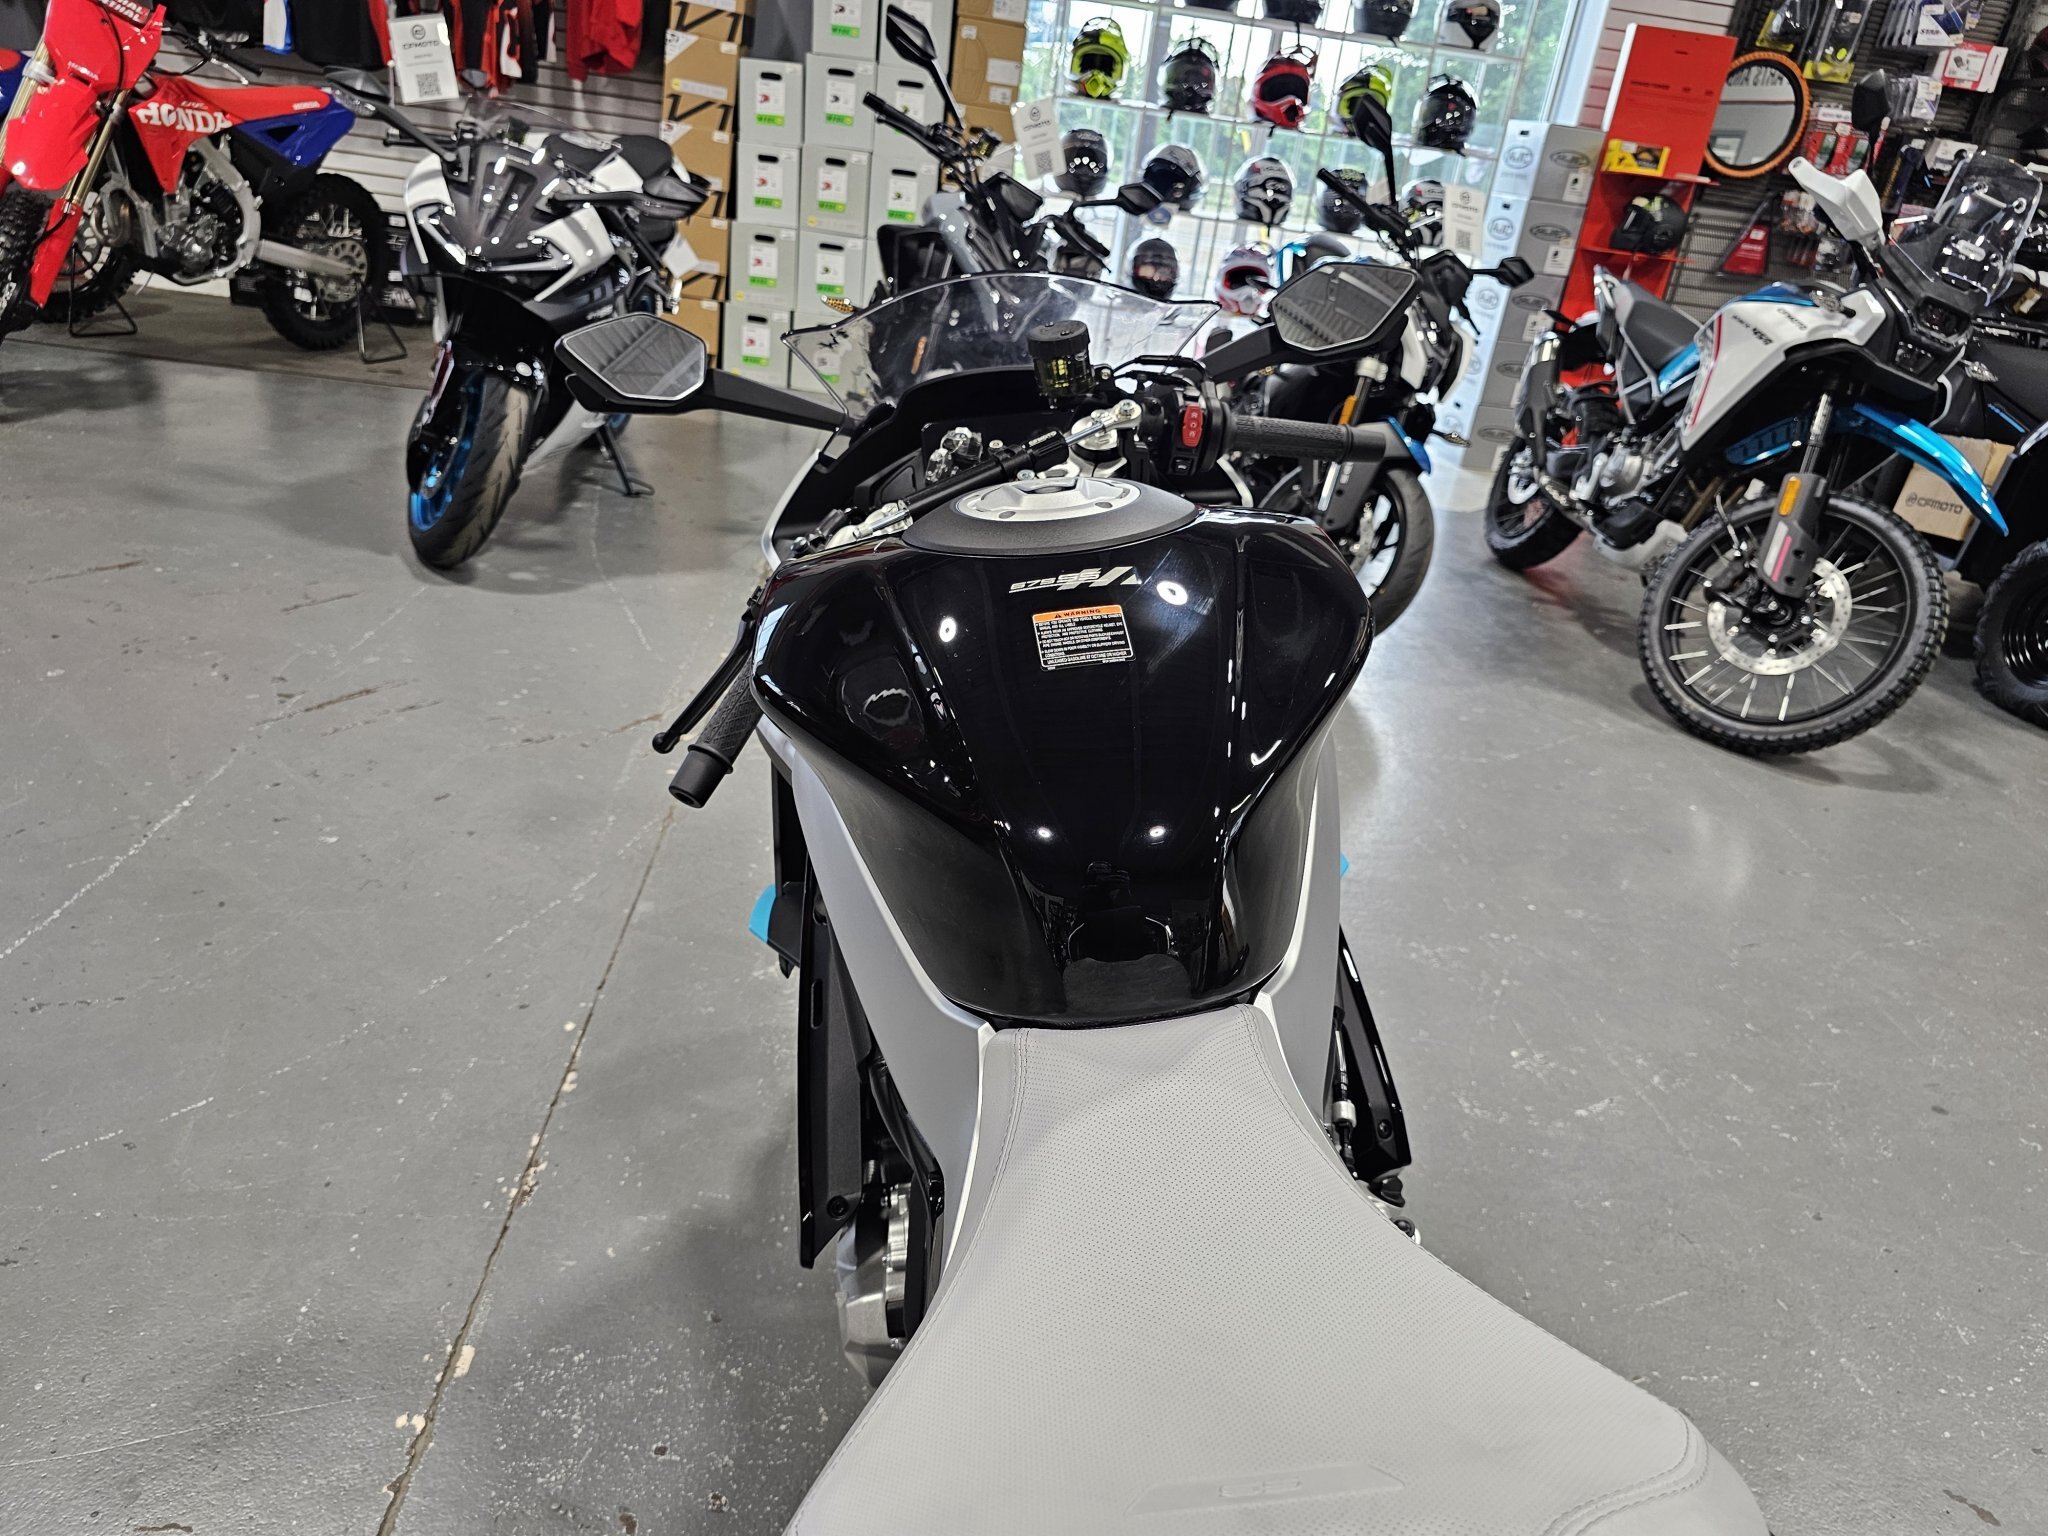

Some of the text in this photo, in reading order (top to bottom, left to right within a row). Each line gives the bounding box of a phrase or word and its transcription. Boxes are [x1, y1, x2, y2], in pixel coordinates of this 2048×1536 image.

[136, 102, 233, 134] HONDA
[1917, 497, 1963, 515] CFMOTO
[1063, 608, 1101, 617] WARNING
